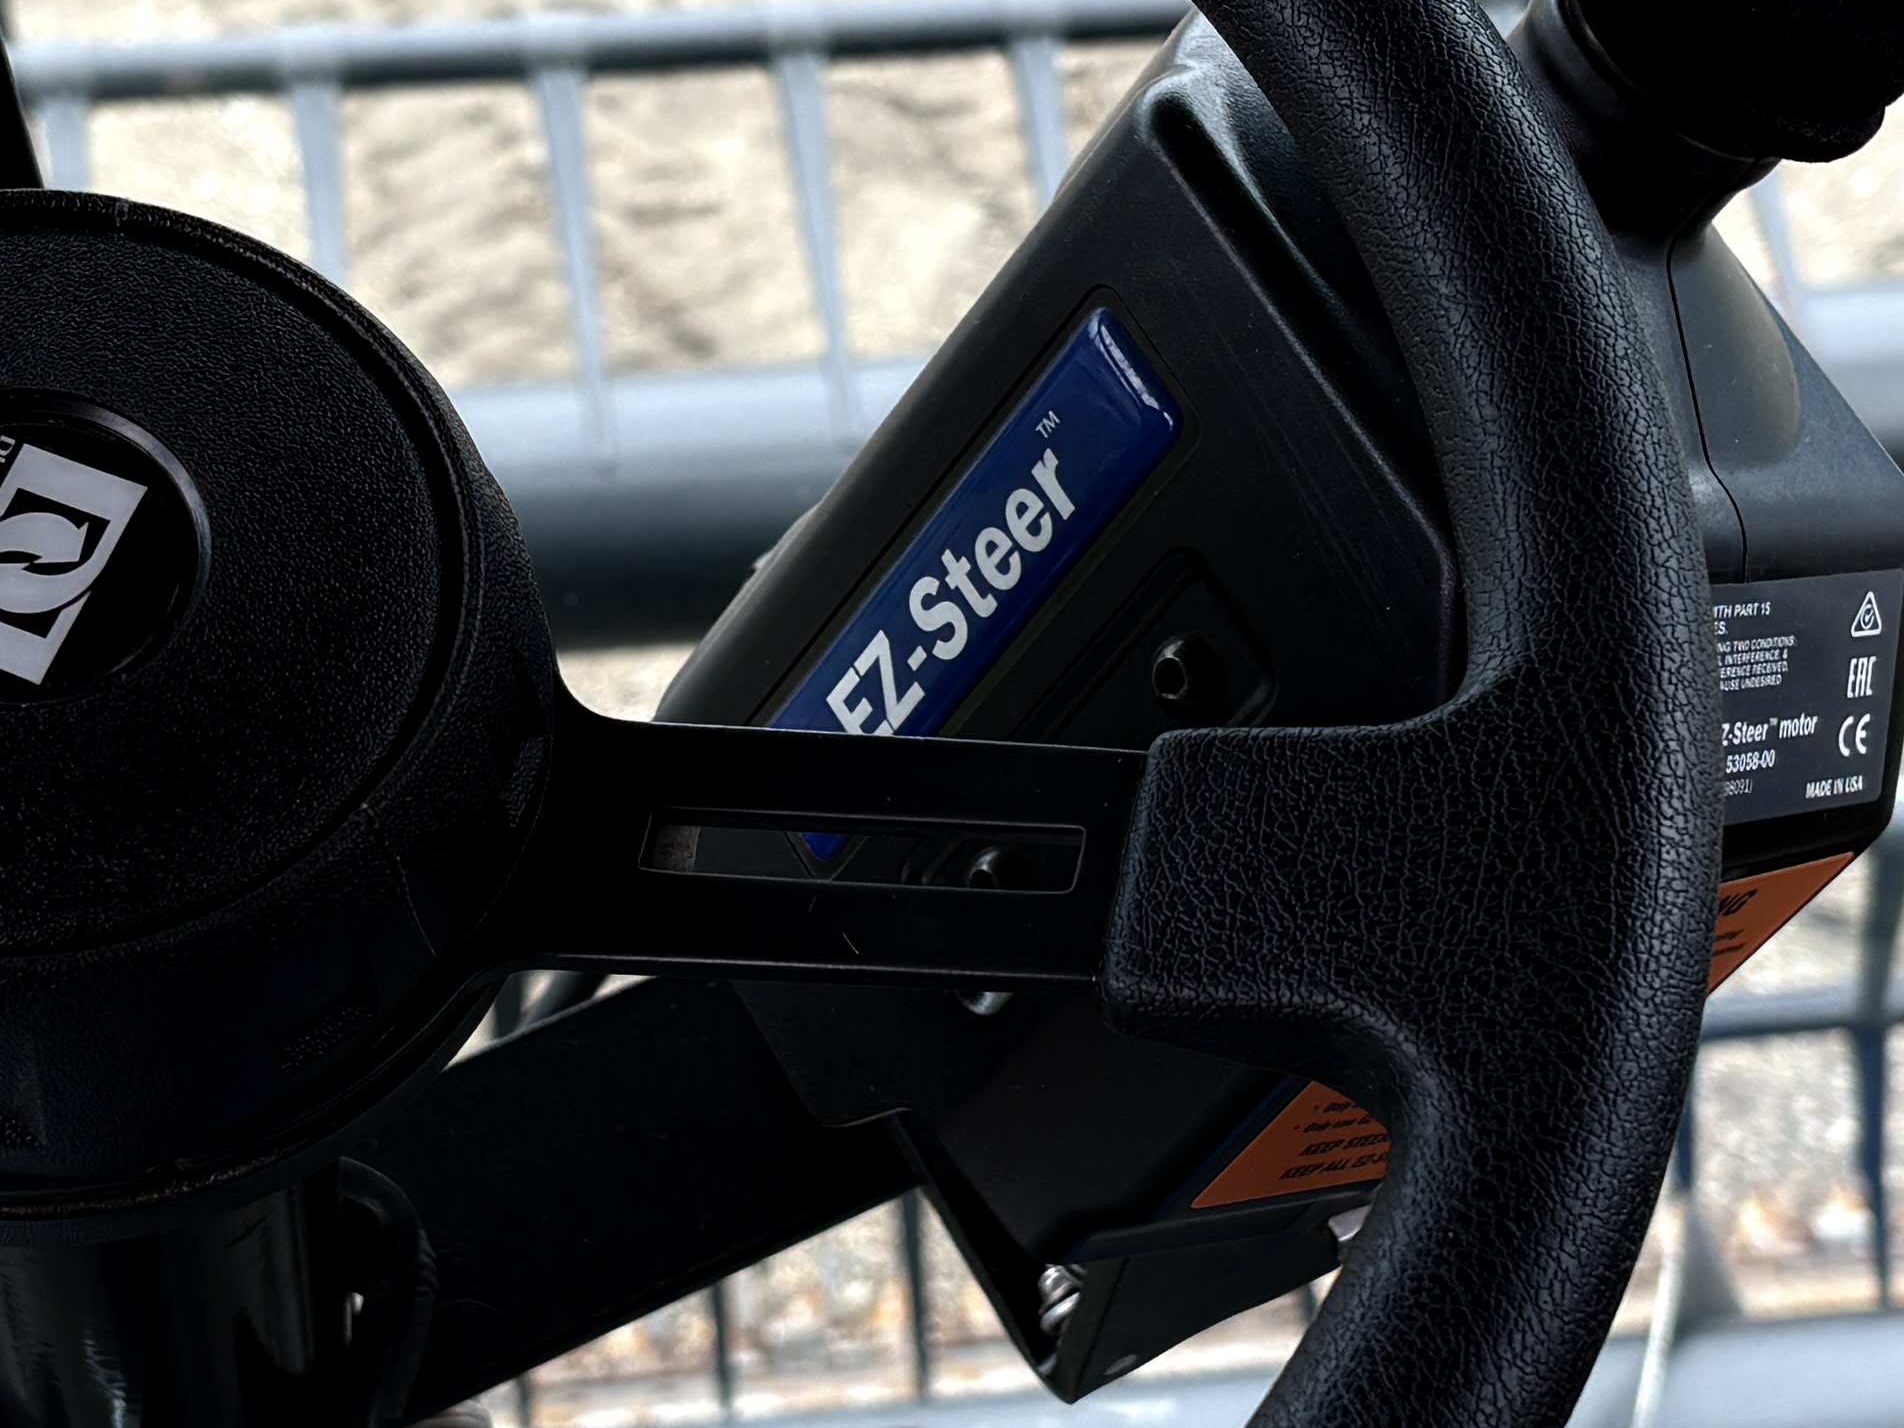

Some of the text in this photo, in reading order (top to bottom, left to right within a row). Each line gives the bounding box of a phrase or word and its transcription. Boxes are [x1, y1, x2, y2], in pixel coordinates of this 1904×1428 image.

[1734, 602, 1759, 618] PART
[1779, 712, 1818, 739] motor
[1805, 775, 1863, 799] MADE IN USA
[1299, 1139, 1345, 1157] KEEP
[1279, 1163, 1325, 1180] KEEP
